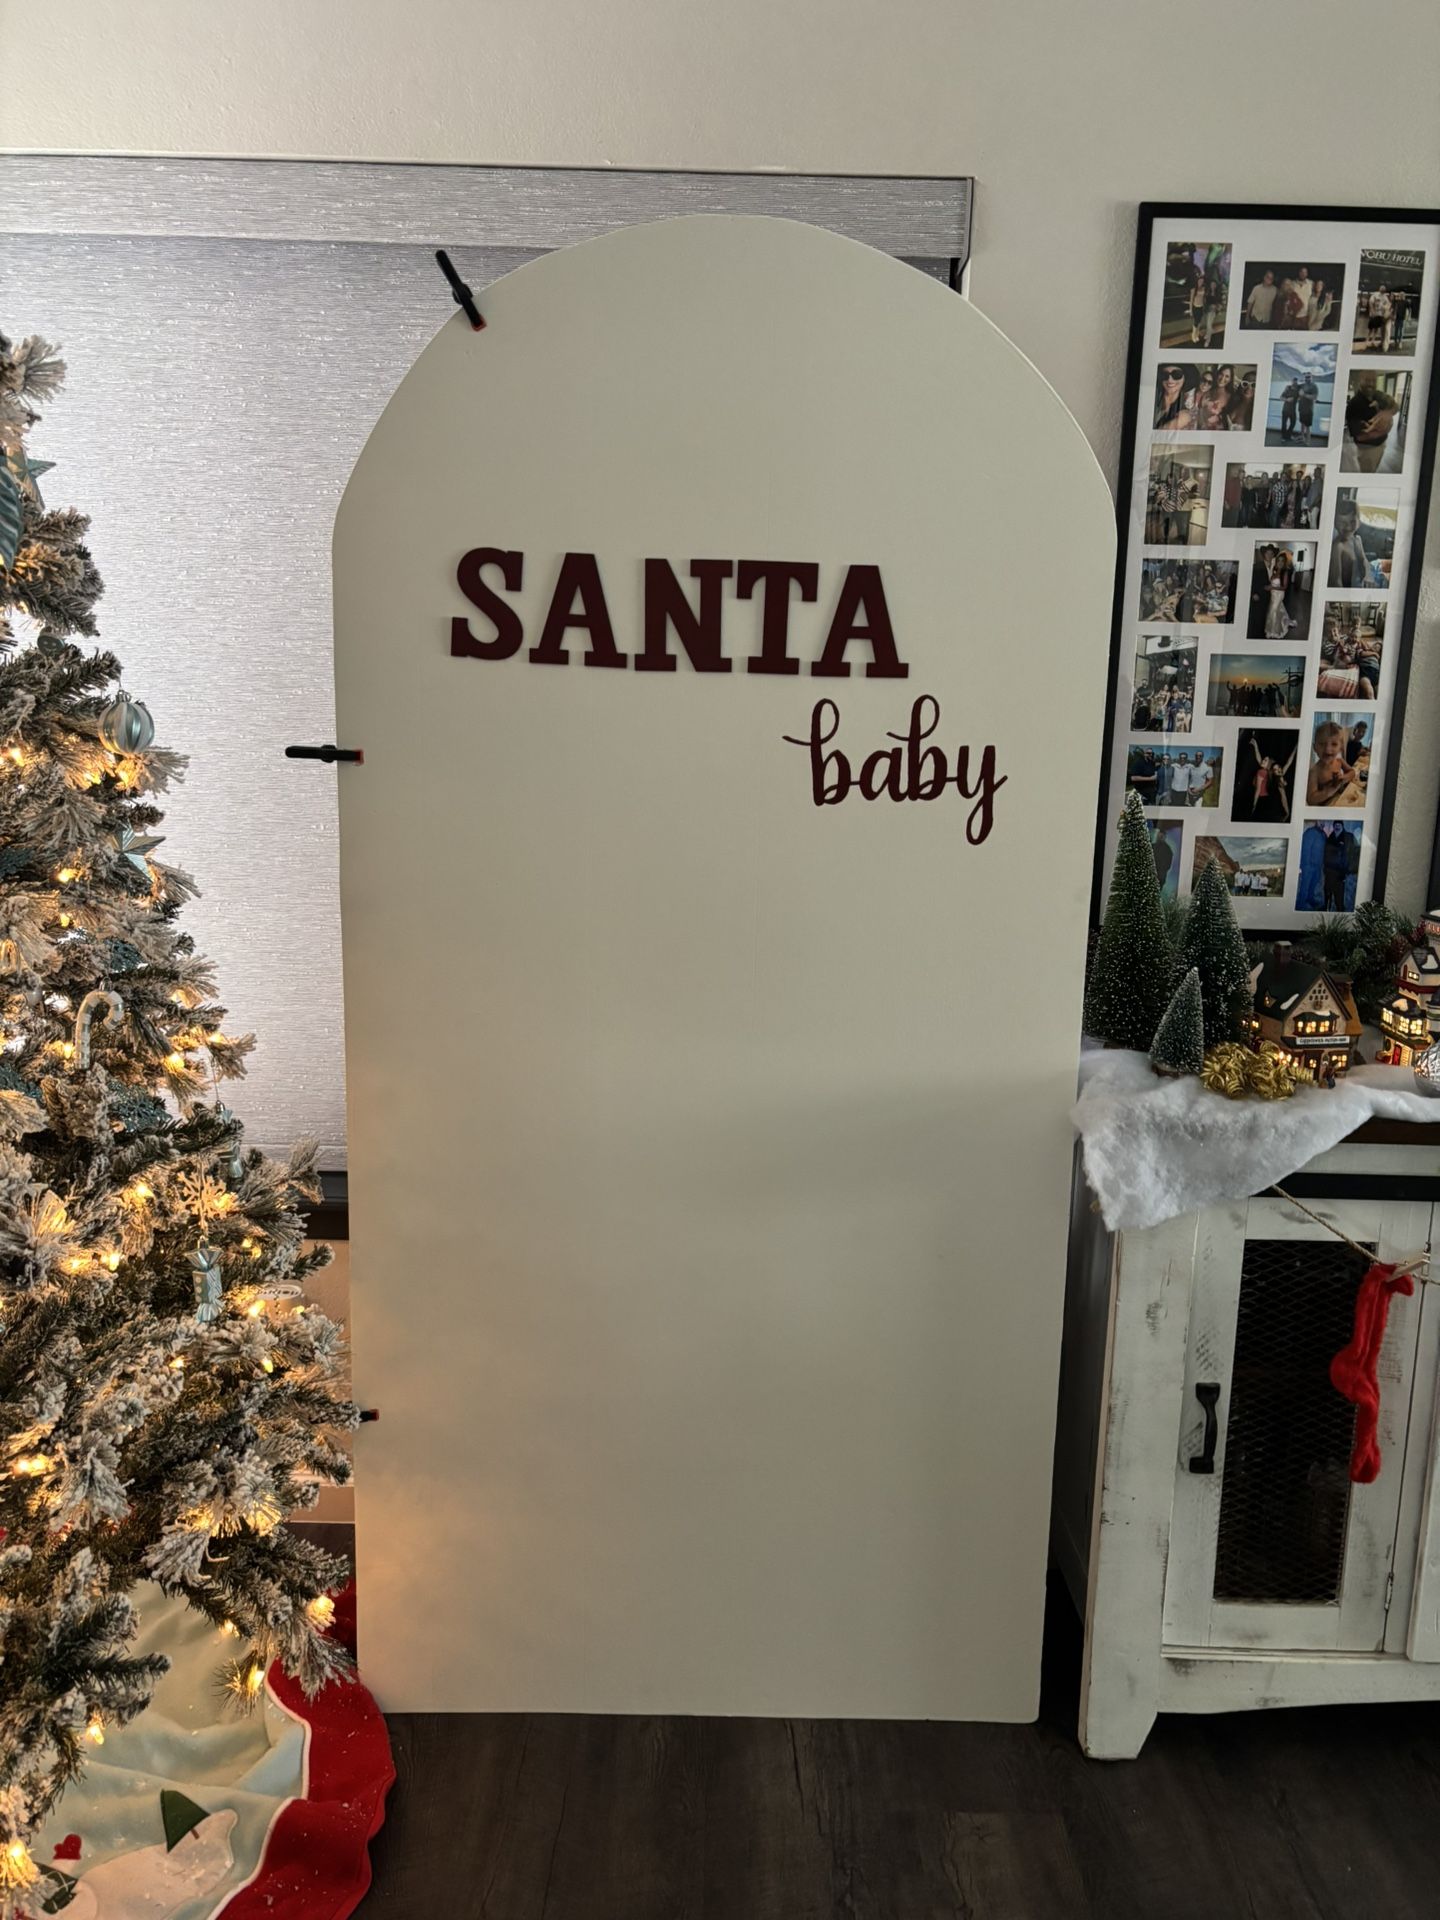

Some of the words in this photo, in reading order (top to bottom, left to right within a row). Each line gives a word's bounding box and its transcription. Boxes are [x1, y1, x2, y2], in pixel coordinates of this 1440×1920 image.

[1392, 253, 1422, 266] HOTEL
[450, 547, 909, 679] SANTA
[782, 694, 1008, 845] baby
